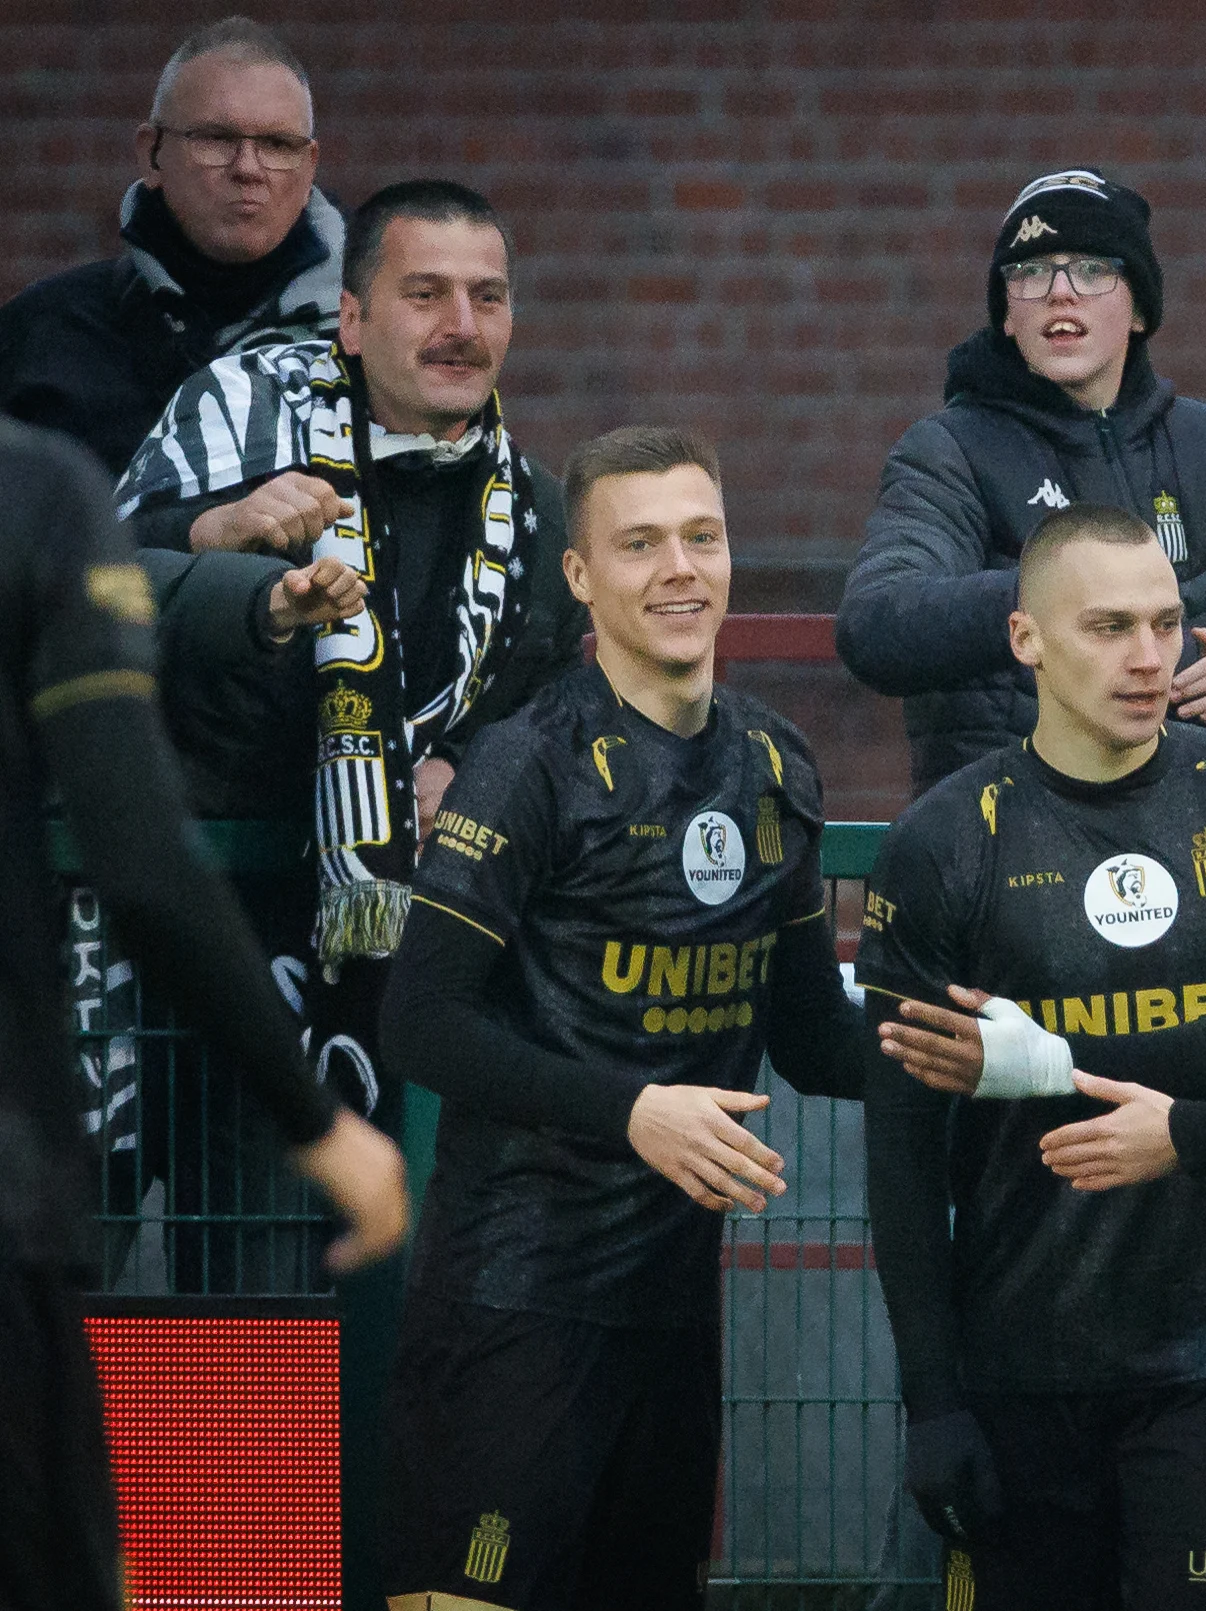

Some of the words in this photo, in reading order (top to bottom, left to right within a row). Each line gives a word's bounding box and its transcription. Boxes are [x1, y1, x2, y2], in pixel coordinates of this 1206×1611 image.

[689, 867, 742, 882] YOUNITED
[1008, 871, 1066, 889] KIPSTA
[1094, 906, 1174, 927] YOUNITED
[602, 931, 778, 998] UNIBET
